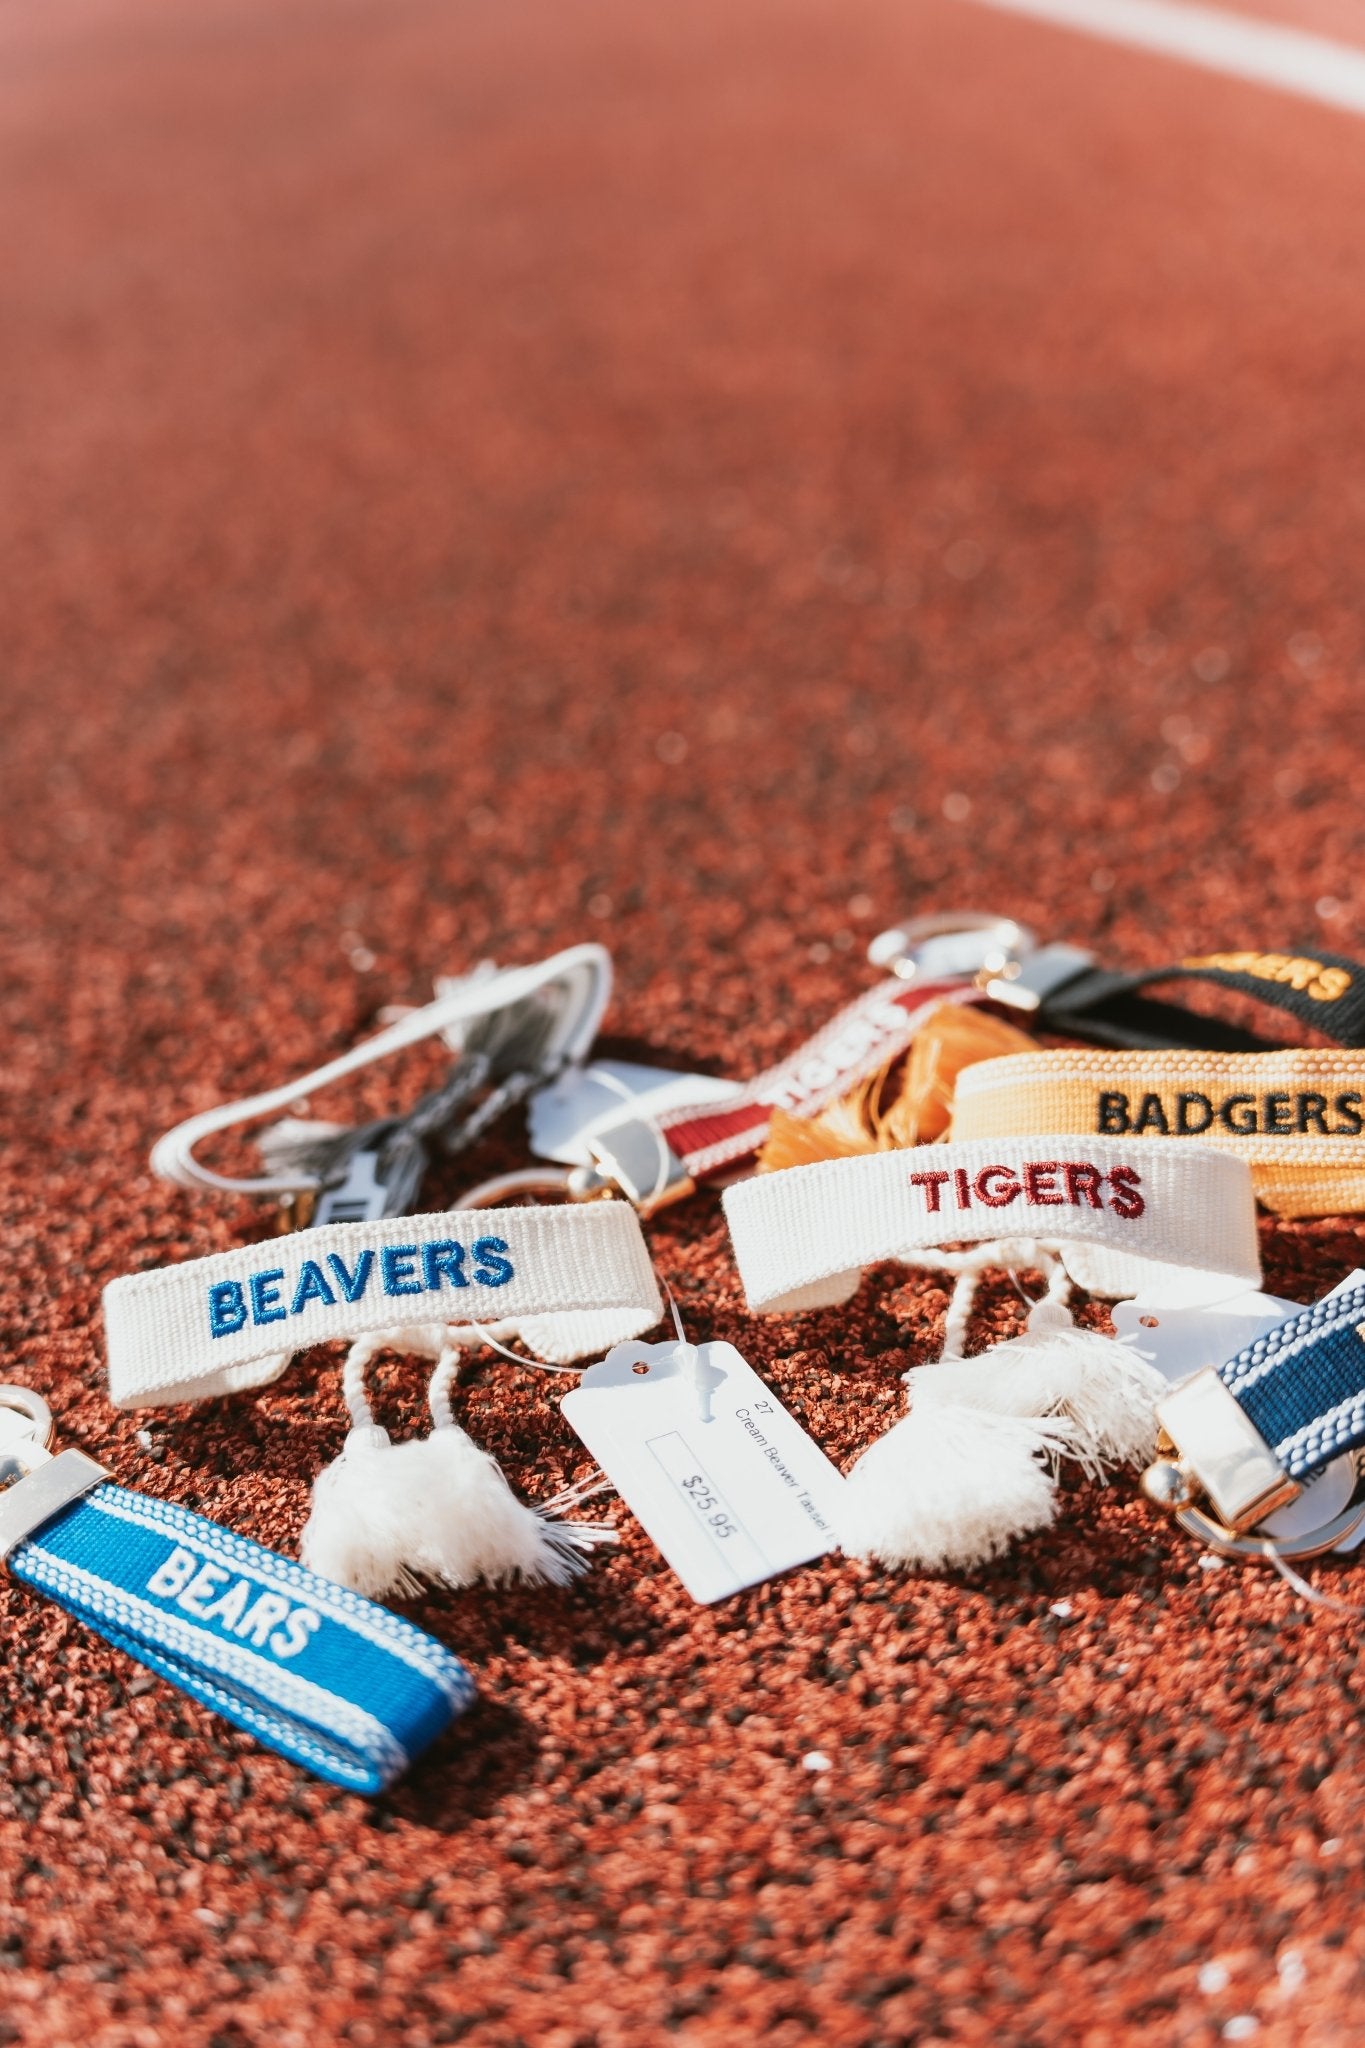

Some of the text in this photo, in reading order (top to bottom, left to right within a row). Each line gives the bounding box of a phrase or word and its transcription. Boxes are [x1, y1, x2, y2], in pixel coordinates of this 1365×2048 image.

[1096, 1091, 1364, 1136] BADGERS
[910, 1160, 1146, 1220] TIGERS
[208, 1235, 515, 1339] BEAVERS
[754, 1400, 775, 1416] 27
[735, 1407, 831, 1531] Cream Beaver Tassel
[682, 1474, 738, 1539] $25.95
[145, 1545, 322, 1659] BEARS
